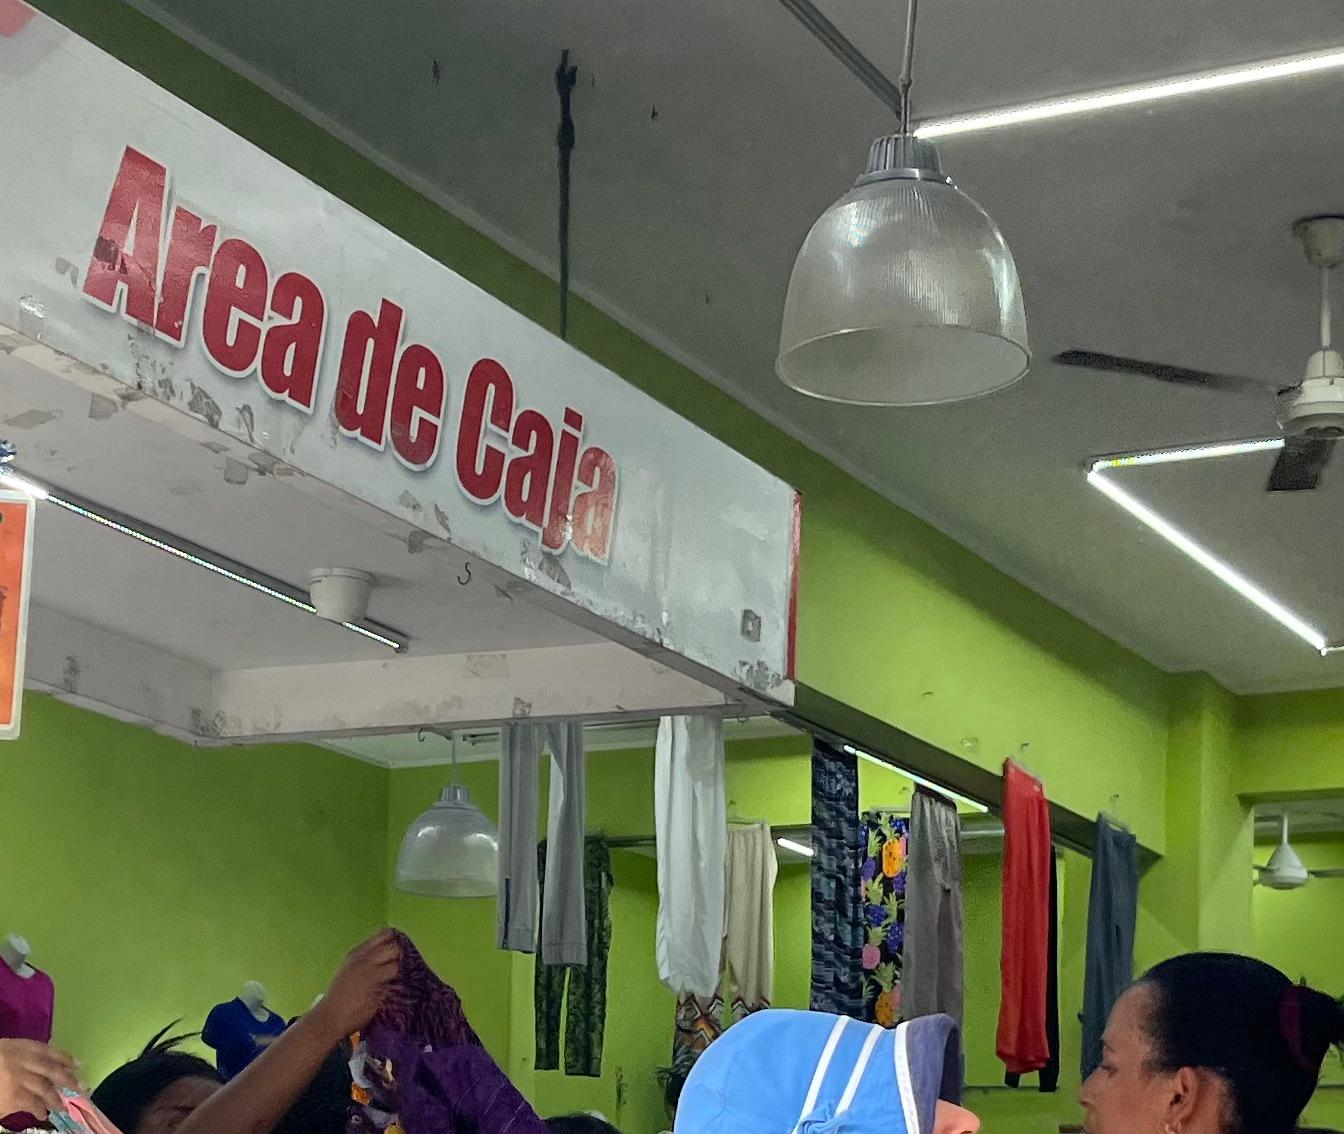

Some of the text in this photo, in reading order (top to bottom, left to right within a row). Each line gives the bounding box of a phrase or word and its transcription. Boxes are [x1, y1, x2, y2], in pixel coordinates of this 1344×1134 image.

[82, 144, 617, 561] Area de Caja
